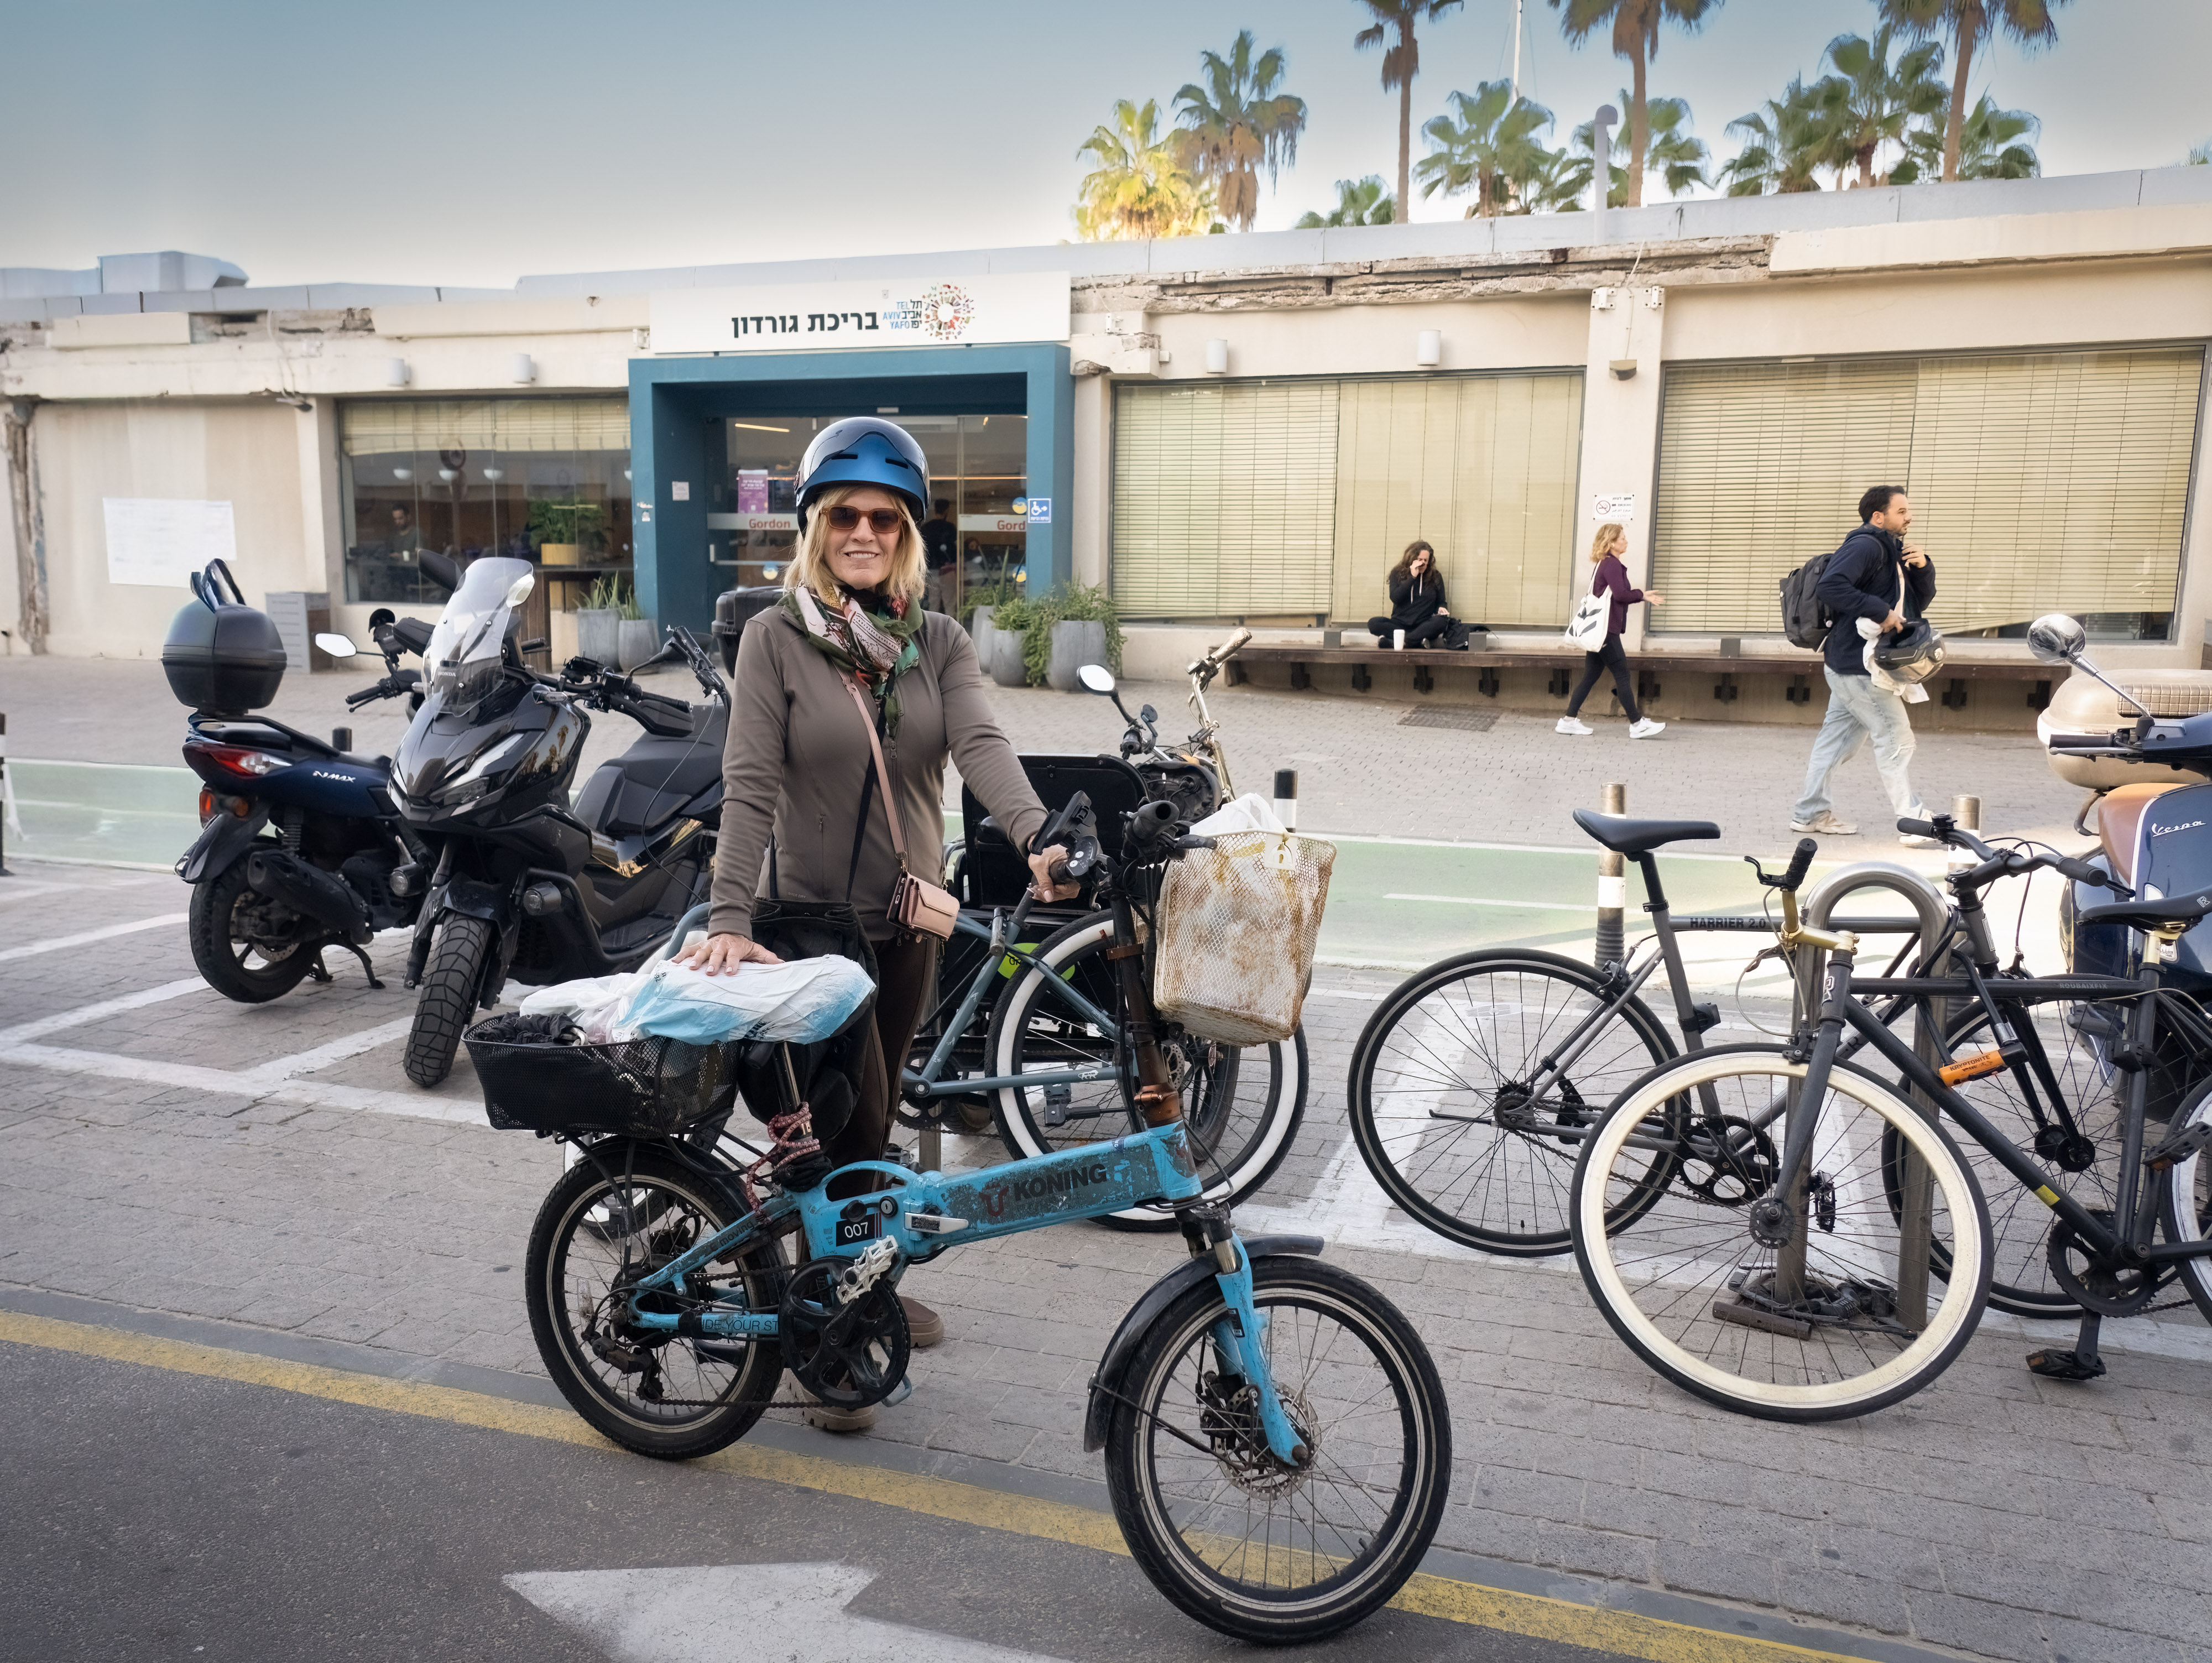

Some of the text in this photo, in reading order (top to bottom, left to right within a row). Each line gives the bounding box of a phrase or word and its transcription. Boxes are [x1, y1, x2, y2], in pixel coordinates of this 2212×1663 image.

[910, 299, 922, 309] תל
[883, 311, 900, 320] AVIV
[901, 311, 921, 319] אביב
[732, 312, 879, 338] בריכת גורדון
[890, 321, 910, 329] YAFO
[749, 518, 790, 529] Gordon
[997, 520, 1025, 530] Gord
[312, 770, 356, 783] NMAX
[2151, 821, 2206, 837] Vespa
[1690, 917, 1766, 929] HARRIER 2.0
[1949, 1054, 1991, 1071] KRYPTONITE
[1014, 1164, 1108, 1201] KONING
[719, 1221, 755, 1247] moving
[844, 1222, 868, 1238] 007
[702, 1320, 722, 1330] IDE
[726, 1320, 760, 1331] YOUR
